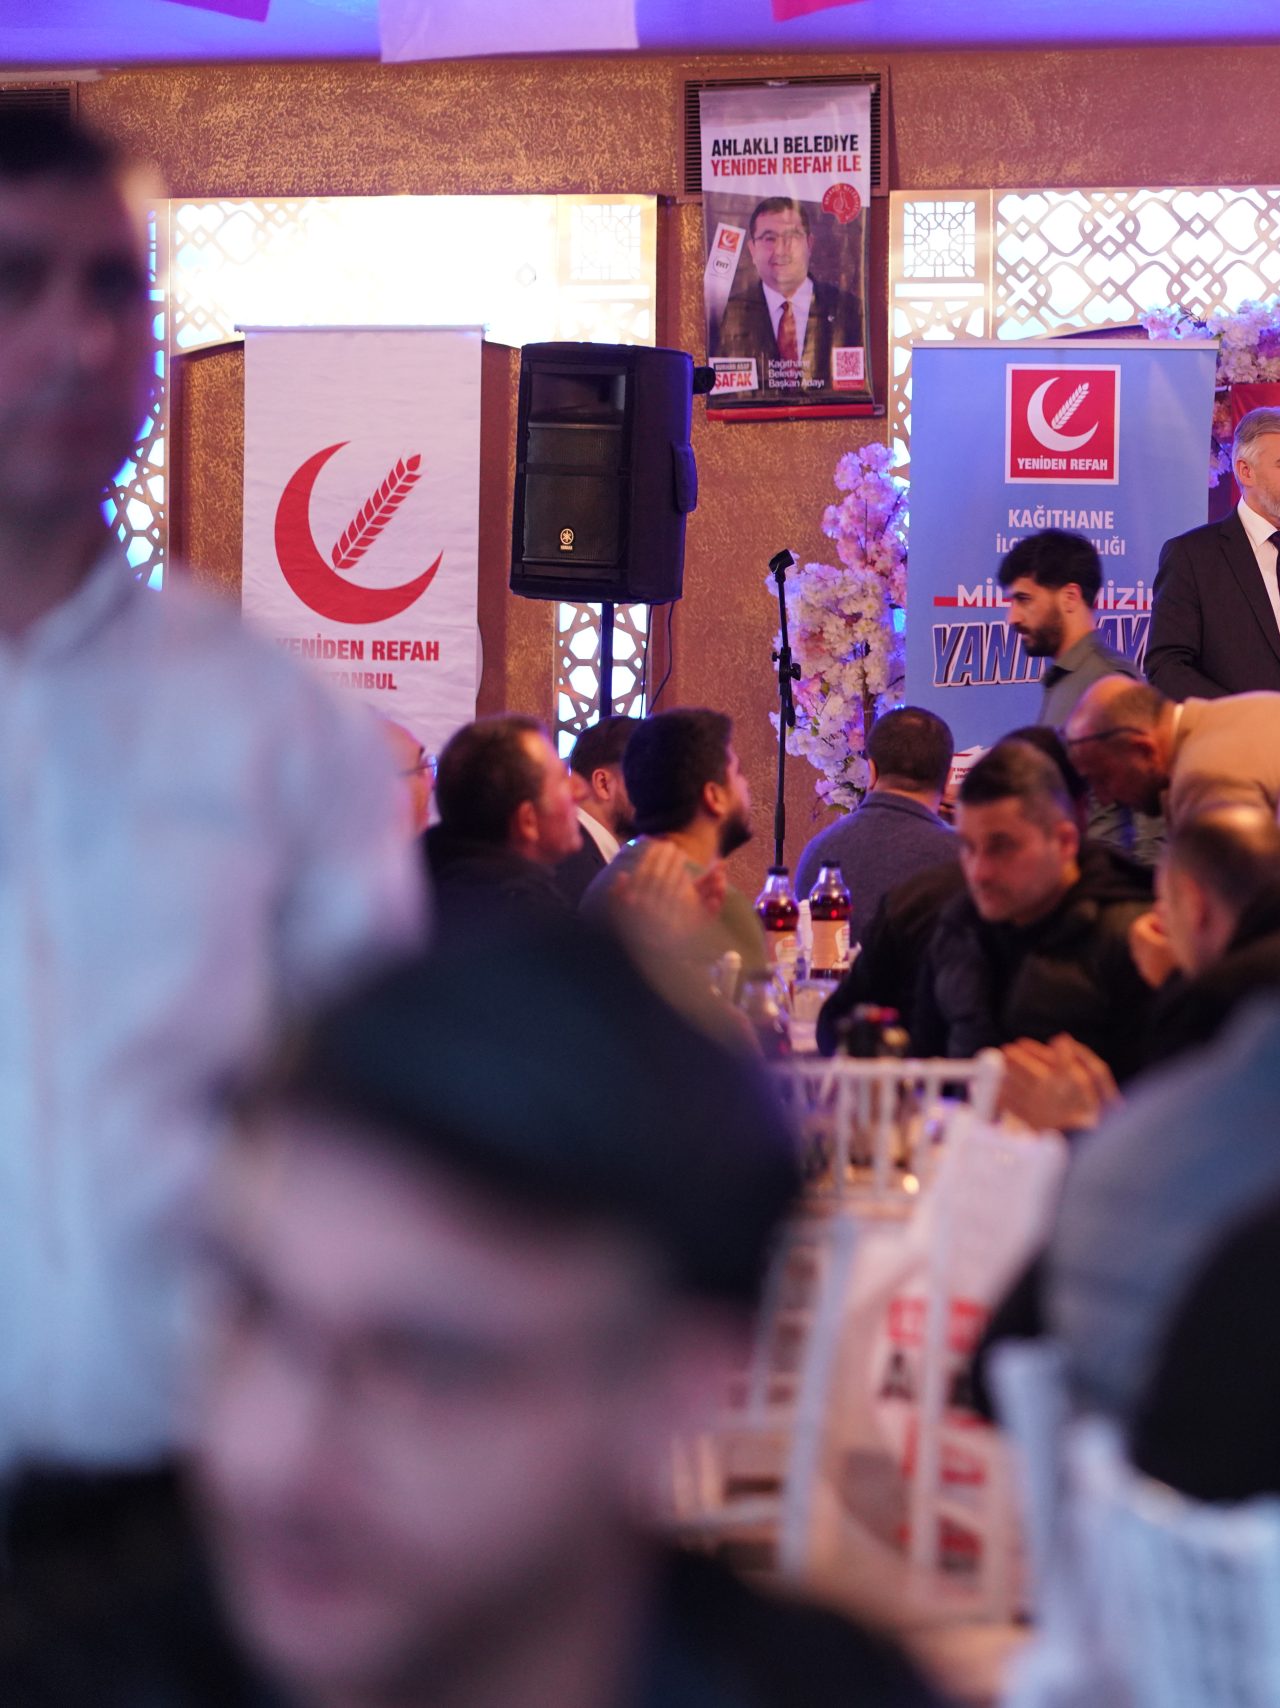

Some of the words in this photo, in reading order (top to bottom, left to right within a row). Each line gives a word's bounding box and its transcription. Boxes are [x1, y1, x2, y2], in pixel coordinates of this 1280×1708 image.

[711, 137, 779, 157] AHLAKLI
[711, 157, 778, 177] YENİDEN
[782, 155, 833, 175] REFAH
[1017, 454, 1067, 471] YENİDEN
[1069, 458, 1108, 471] REFAH
[1008, 505, 1114, 530] KAĞITHANE
[371, 639, 440, 662] REFAH
[330, 671, 398, 690] TANBUL
